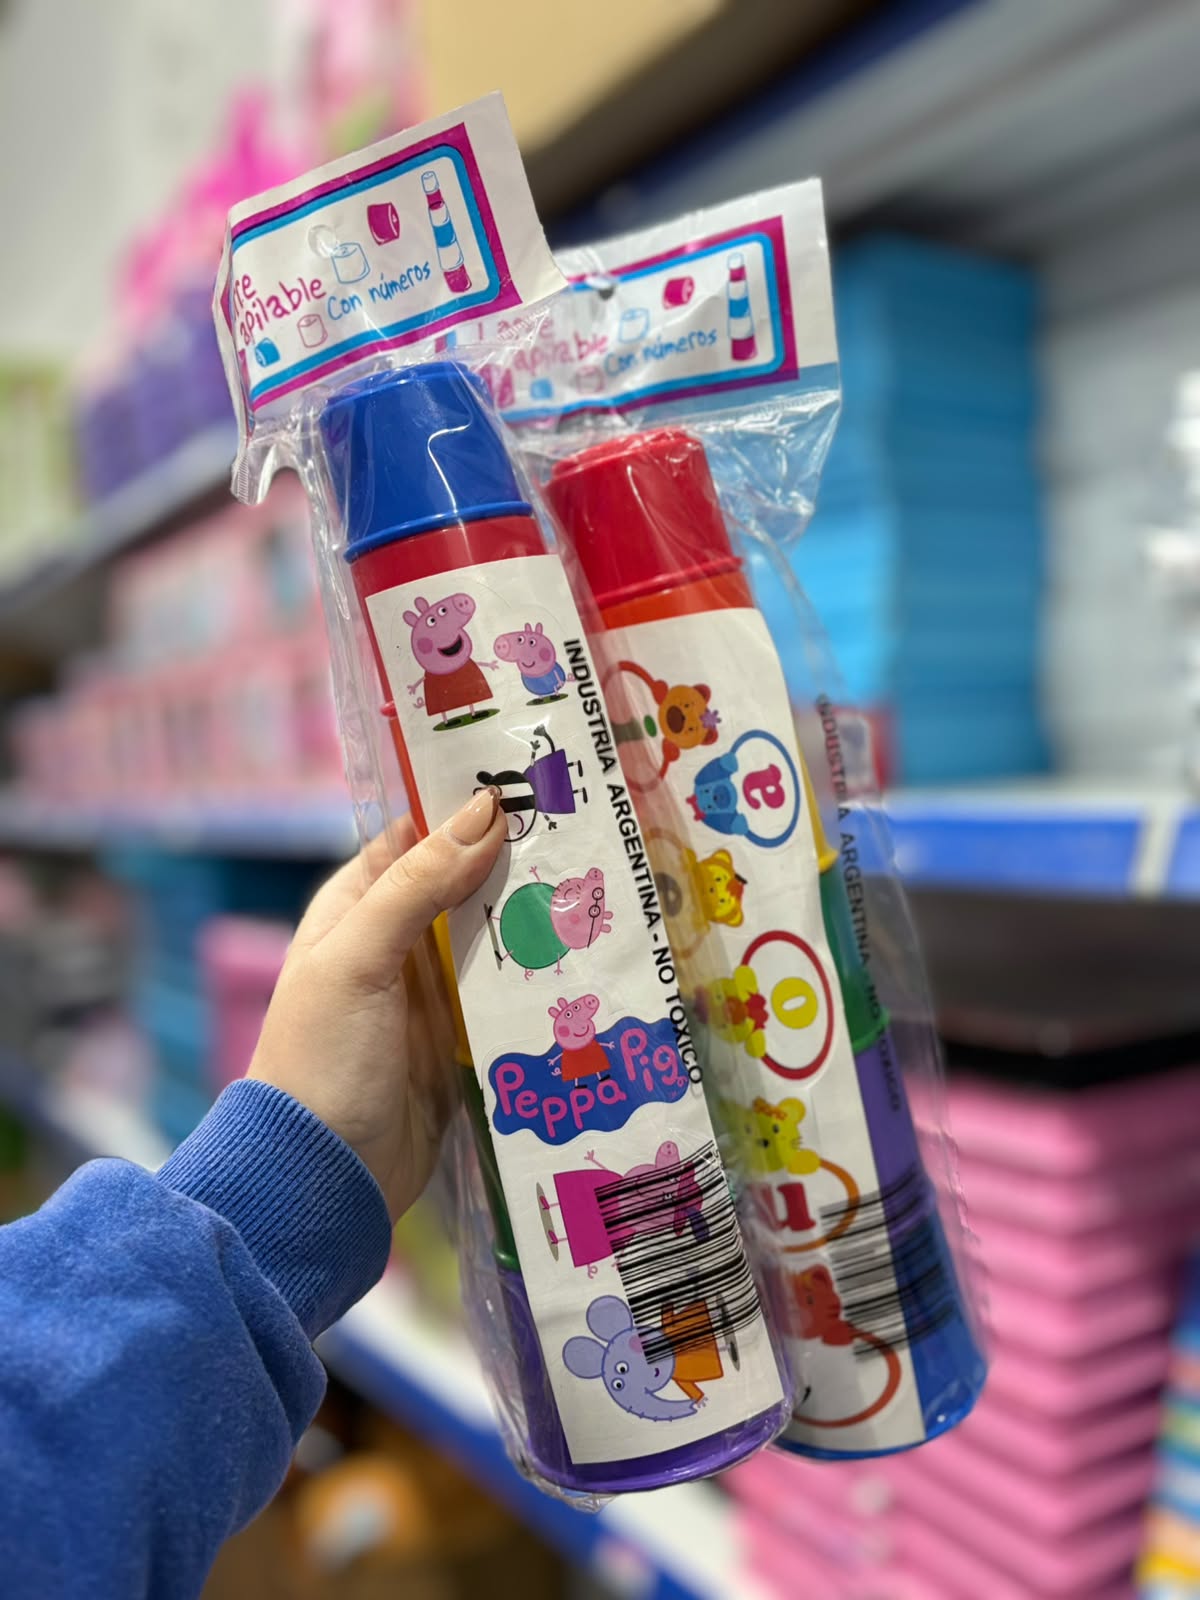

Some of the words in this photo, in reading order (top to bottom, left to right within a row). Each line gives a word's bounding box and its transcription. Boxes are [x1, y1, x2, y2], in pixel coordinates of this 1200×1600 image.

[239, 276, 327, 346] apilable
[327, 294, 364, 320] Con
[367, 261, 431, 303] números
[642, 328, 718, 362] números
[563, 638, 617, 774] INDUSTRIA
[607, 783, 662, 928] ARGENTINA
[652, 946, 676, 985] NO
[665, 988, 704, 1085] TOXICO
[494, 1062, 627, 1138] Peppa
[619, 1027, 688, 1092] Pig
